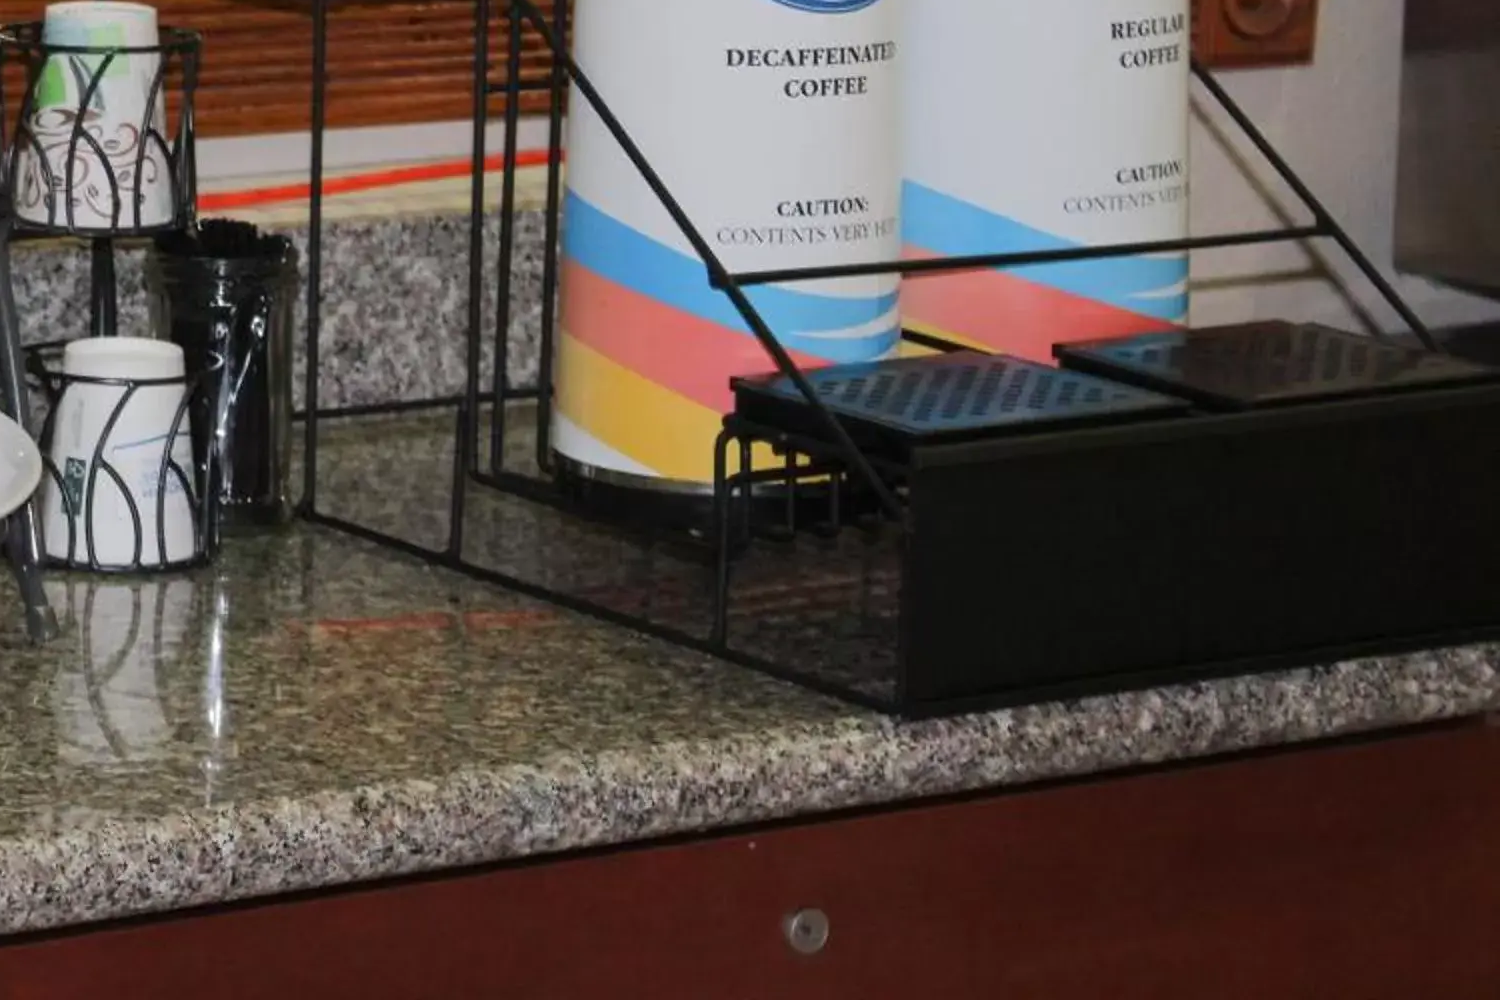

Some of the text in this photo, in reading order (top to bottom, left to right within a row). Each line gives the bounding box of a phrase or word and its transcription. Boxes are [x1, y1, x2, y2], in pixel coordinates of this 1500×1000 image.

[1119, 44, 1180, 69] COFFEE
[783, 76, 868, 98] COFFEE
[716, 227, 828, 245] CONTENTS
